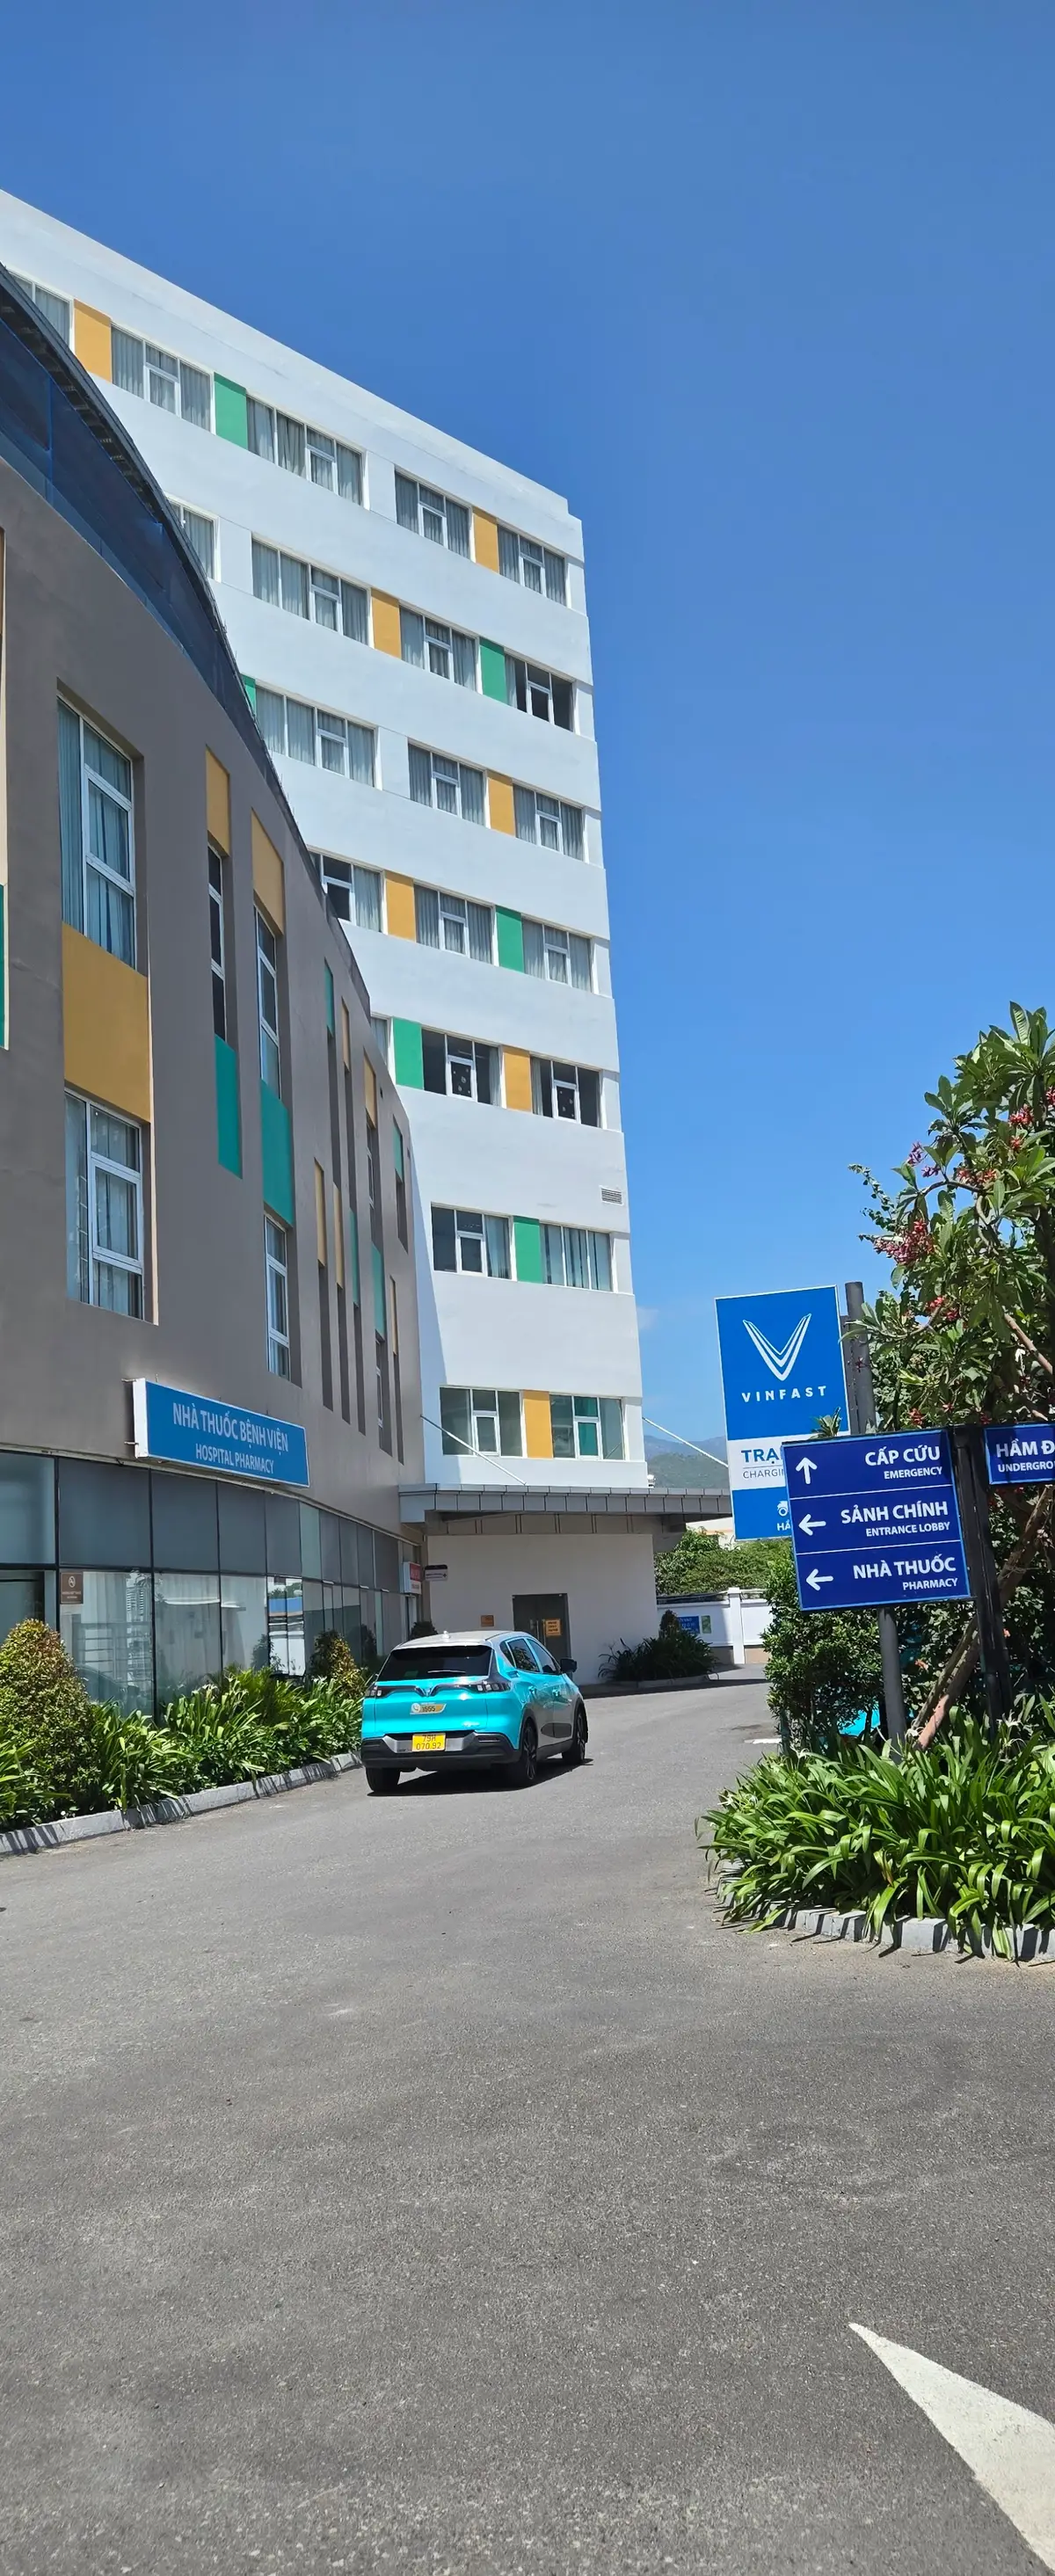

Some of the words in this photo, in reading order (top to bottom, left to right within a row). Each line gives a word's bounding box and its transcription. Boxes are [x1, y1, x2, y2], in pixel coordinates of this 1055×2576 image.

[742, 1385, 827, 1403] VINFAST
[172, 1402, 199, 1430] NHÀ
[200, 1409, 238, 1441] THUỐC
[239, 1418, 266, 1449] BỆNH
[266, 1427, 289, 1455] VIỆN
[740, 1447, 783, 1465] TRẠ
[864, 1446, 899, 1466] CẤP
[903, 1444, 941, 1463] CỨU
[995, 1437, 1039, 1458] HẦM
[195, 1443, 234, 1466] HOSPITAL
[234, 1452, 274, 1474] PHARMACY
[997, 1460, 1055, 1473] UNDERGRO
[884, 1466, 943, 1480] EMERGENCY
[840, 1504, 889, 1525] SẢNH
[892, 1500, 949, 1520] CHÍNH
[866, 1524, 919, 1538] ENTRANCE
[920, 1521, 950, 1534] LOBBY
[853, 1560, 891, 1580] NHÀ
[893, 1553, 957, 1576] THUỐC
[903, 1577, 958, 1591] PHARMACY
